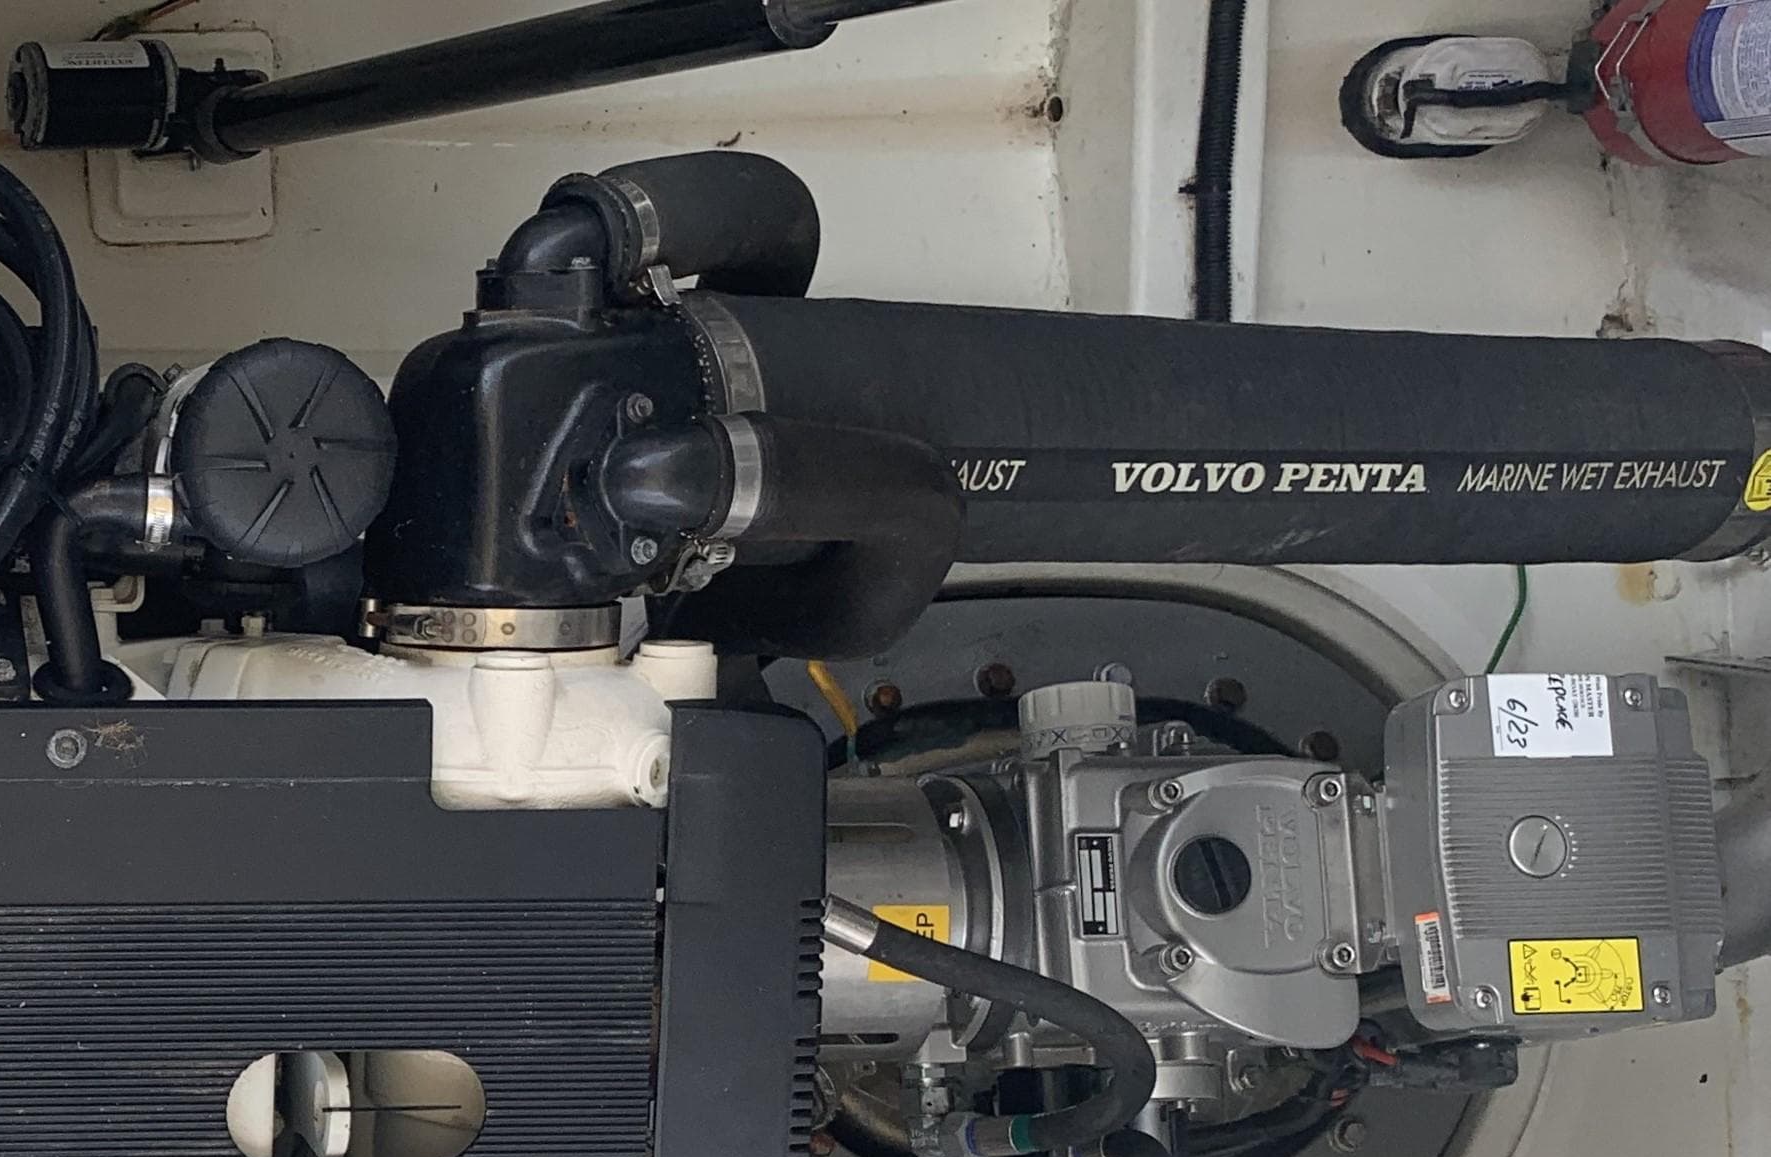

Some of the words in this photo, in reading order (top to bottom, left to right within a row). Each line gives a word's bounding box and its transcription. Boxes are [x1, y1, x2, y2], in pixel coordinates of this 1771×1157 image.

[952, 460, 1025, 492] AUST
[1112, 461, 1266, 494] VOLVO
[1272, 461, 1427, 494] PENTA
[1458, 461, 1558, 493] MARINE
[1560, 461, 1612, 491] WET
[1614, 459, 1727, 491] EXHAUST
[1498, 699, 1539, 749] 6/23
[1256, 804, 1283, 948] PENTA
[1278, 807, 1306, 942] VOLVO
